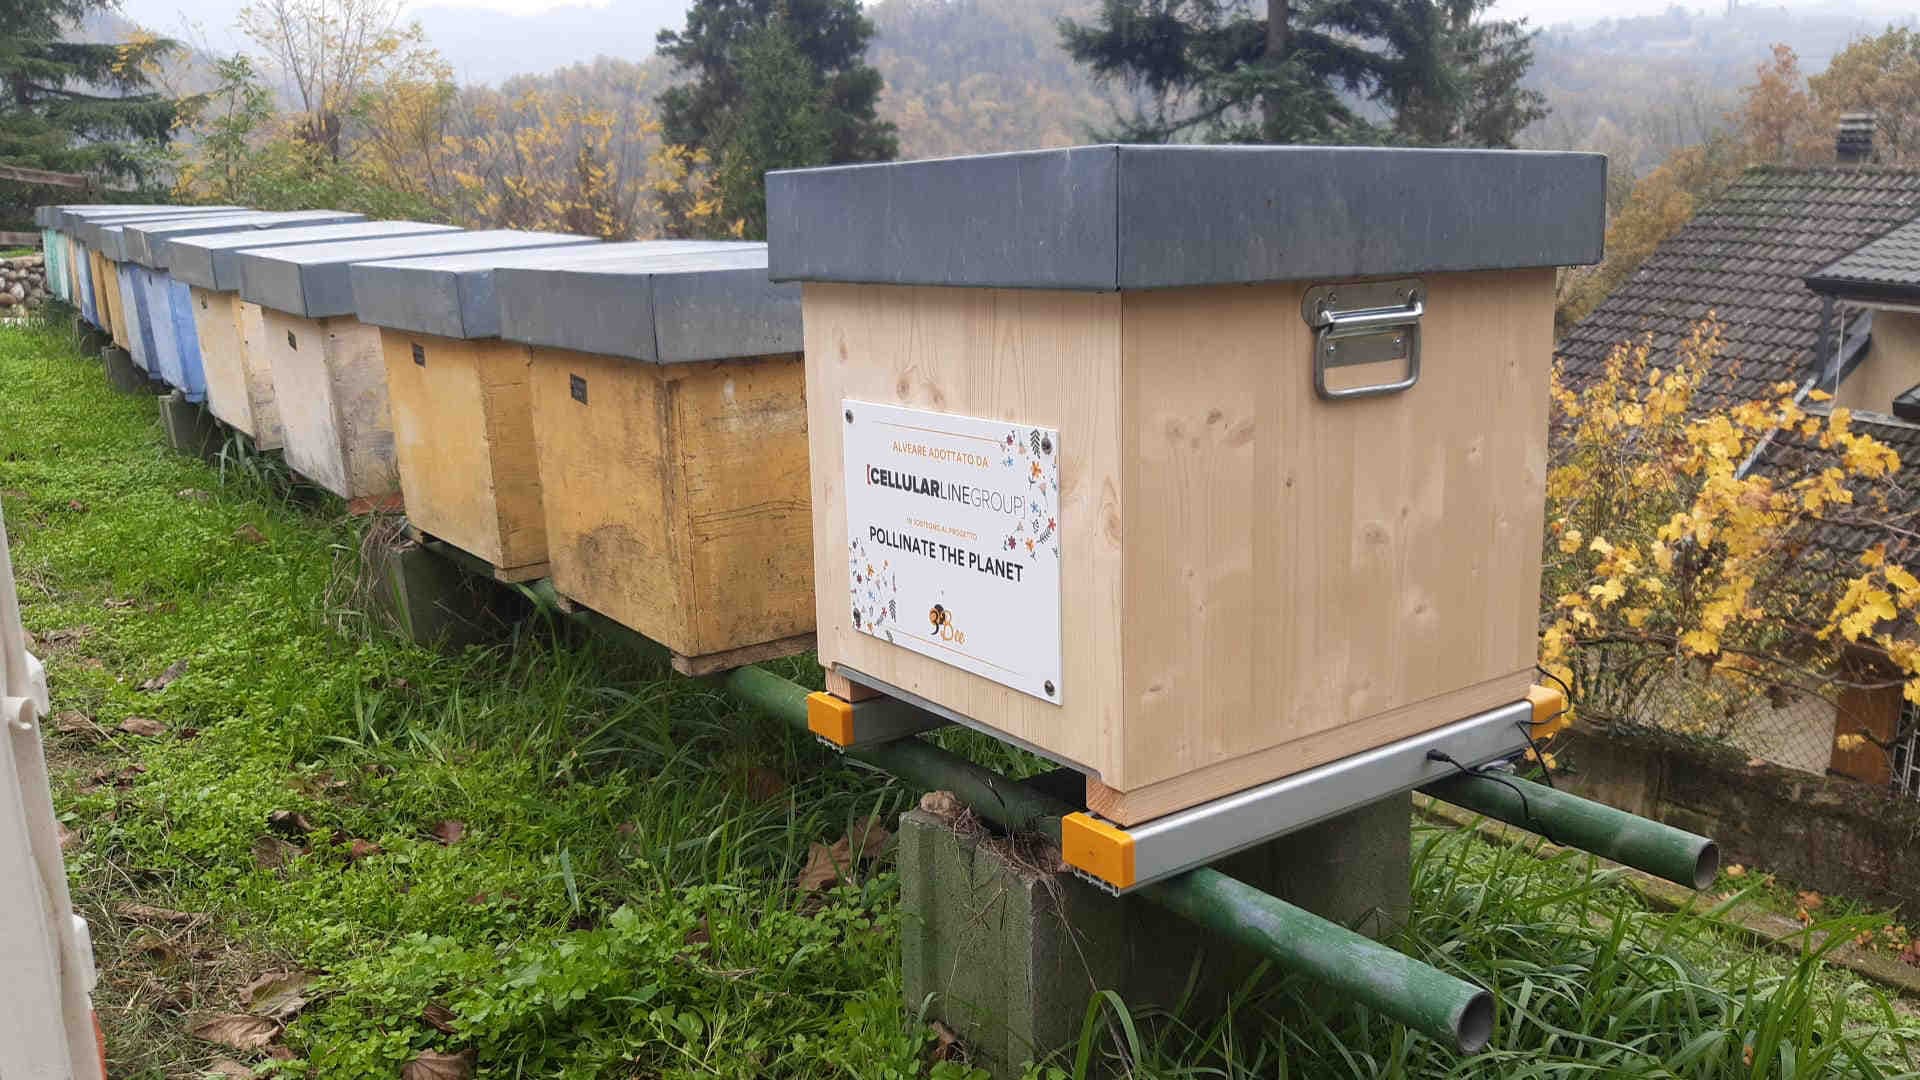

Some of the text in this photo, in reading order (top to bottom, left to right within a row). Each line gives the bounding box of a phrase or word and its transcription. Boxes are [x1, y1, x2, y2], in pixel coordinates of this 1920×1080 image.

[893, 440, 988, 468] ALVEARE ADOTTATO DA
[869, 525, 1023, 583] POLLINATE THE PLANET
